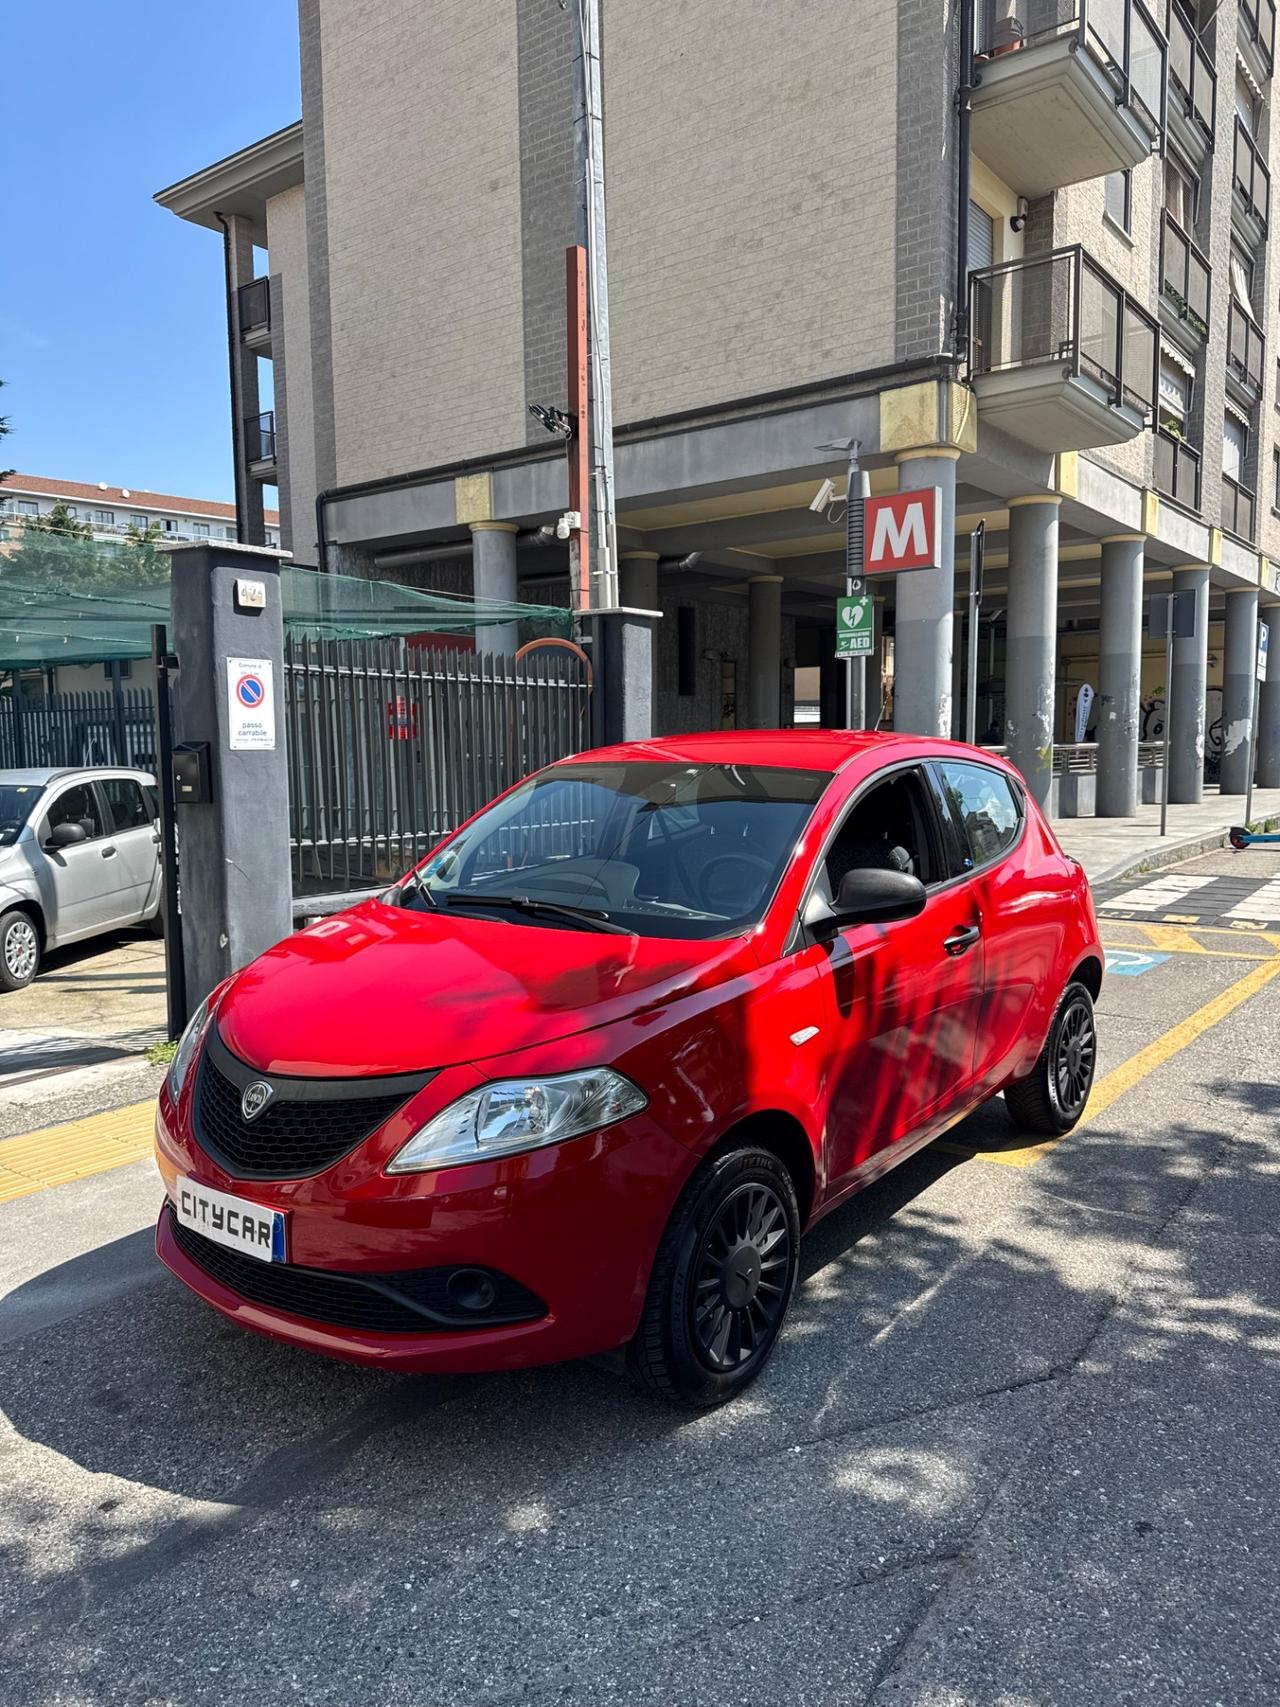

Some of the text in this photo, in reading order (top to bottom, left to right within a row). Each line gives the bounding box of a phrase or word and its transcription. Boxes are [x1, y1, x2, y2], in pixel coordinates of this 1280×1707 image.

[869, 502, 929, 562] M
[849, 637, 870, 649] AED
[1260, 626, 1267, 649] P
[181, 1190, 271, 1249] CITYCAR
